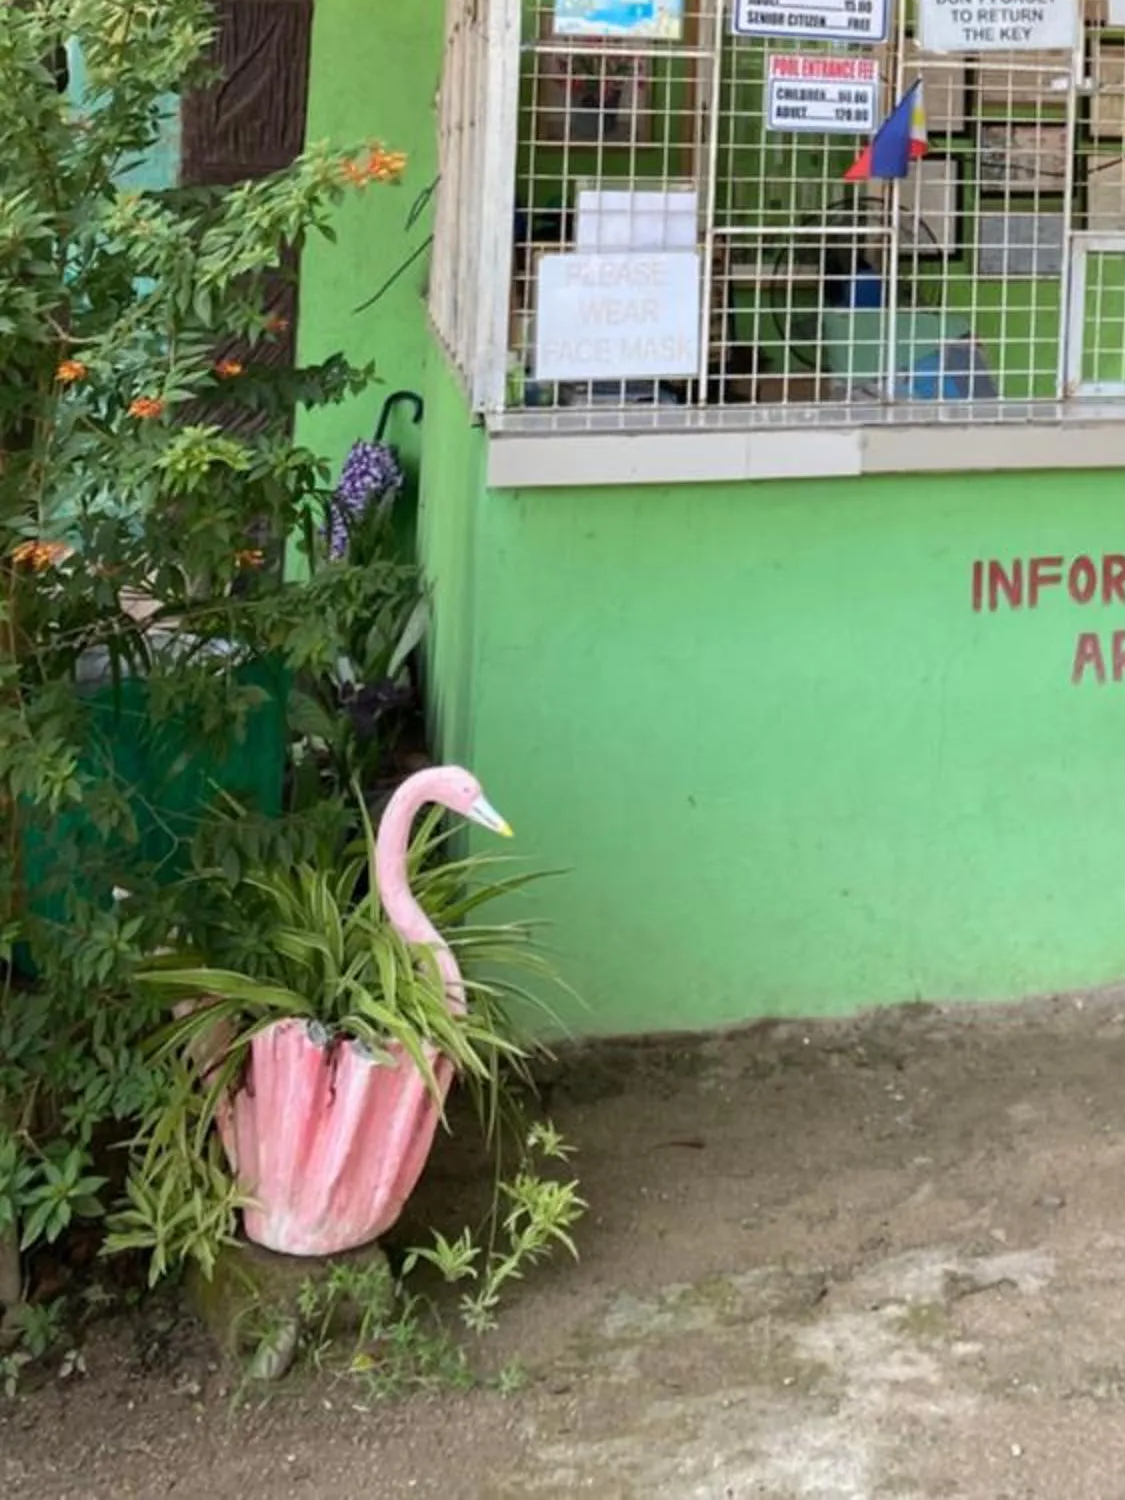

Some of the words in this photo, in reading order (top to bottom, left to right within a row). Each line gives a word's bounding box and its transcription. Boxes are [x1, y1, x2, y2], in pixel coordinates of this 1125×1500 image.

[747, 11, 785, 26] SENIOR
[787, 13, 827, 28] CITIZEN
[951, 8, 972, 23] TO
[977, 8, 1043, 23] RETURN
[962, 27, 995, 42] THE
[999, 27, 1032, 41] KEY
[565, 260, 669, 287] PLEASE
[577, 296, 660, 326] WEAR
[541, 336, 612, 365] FACE
